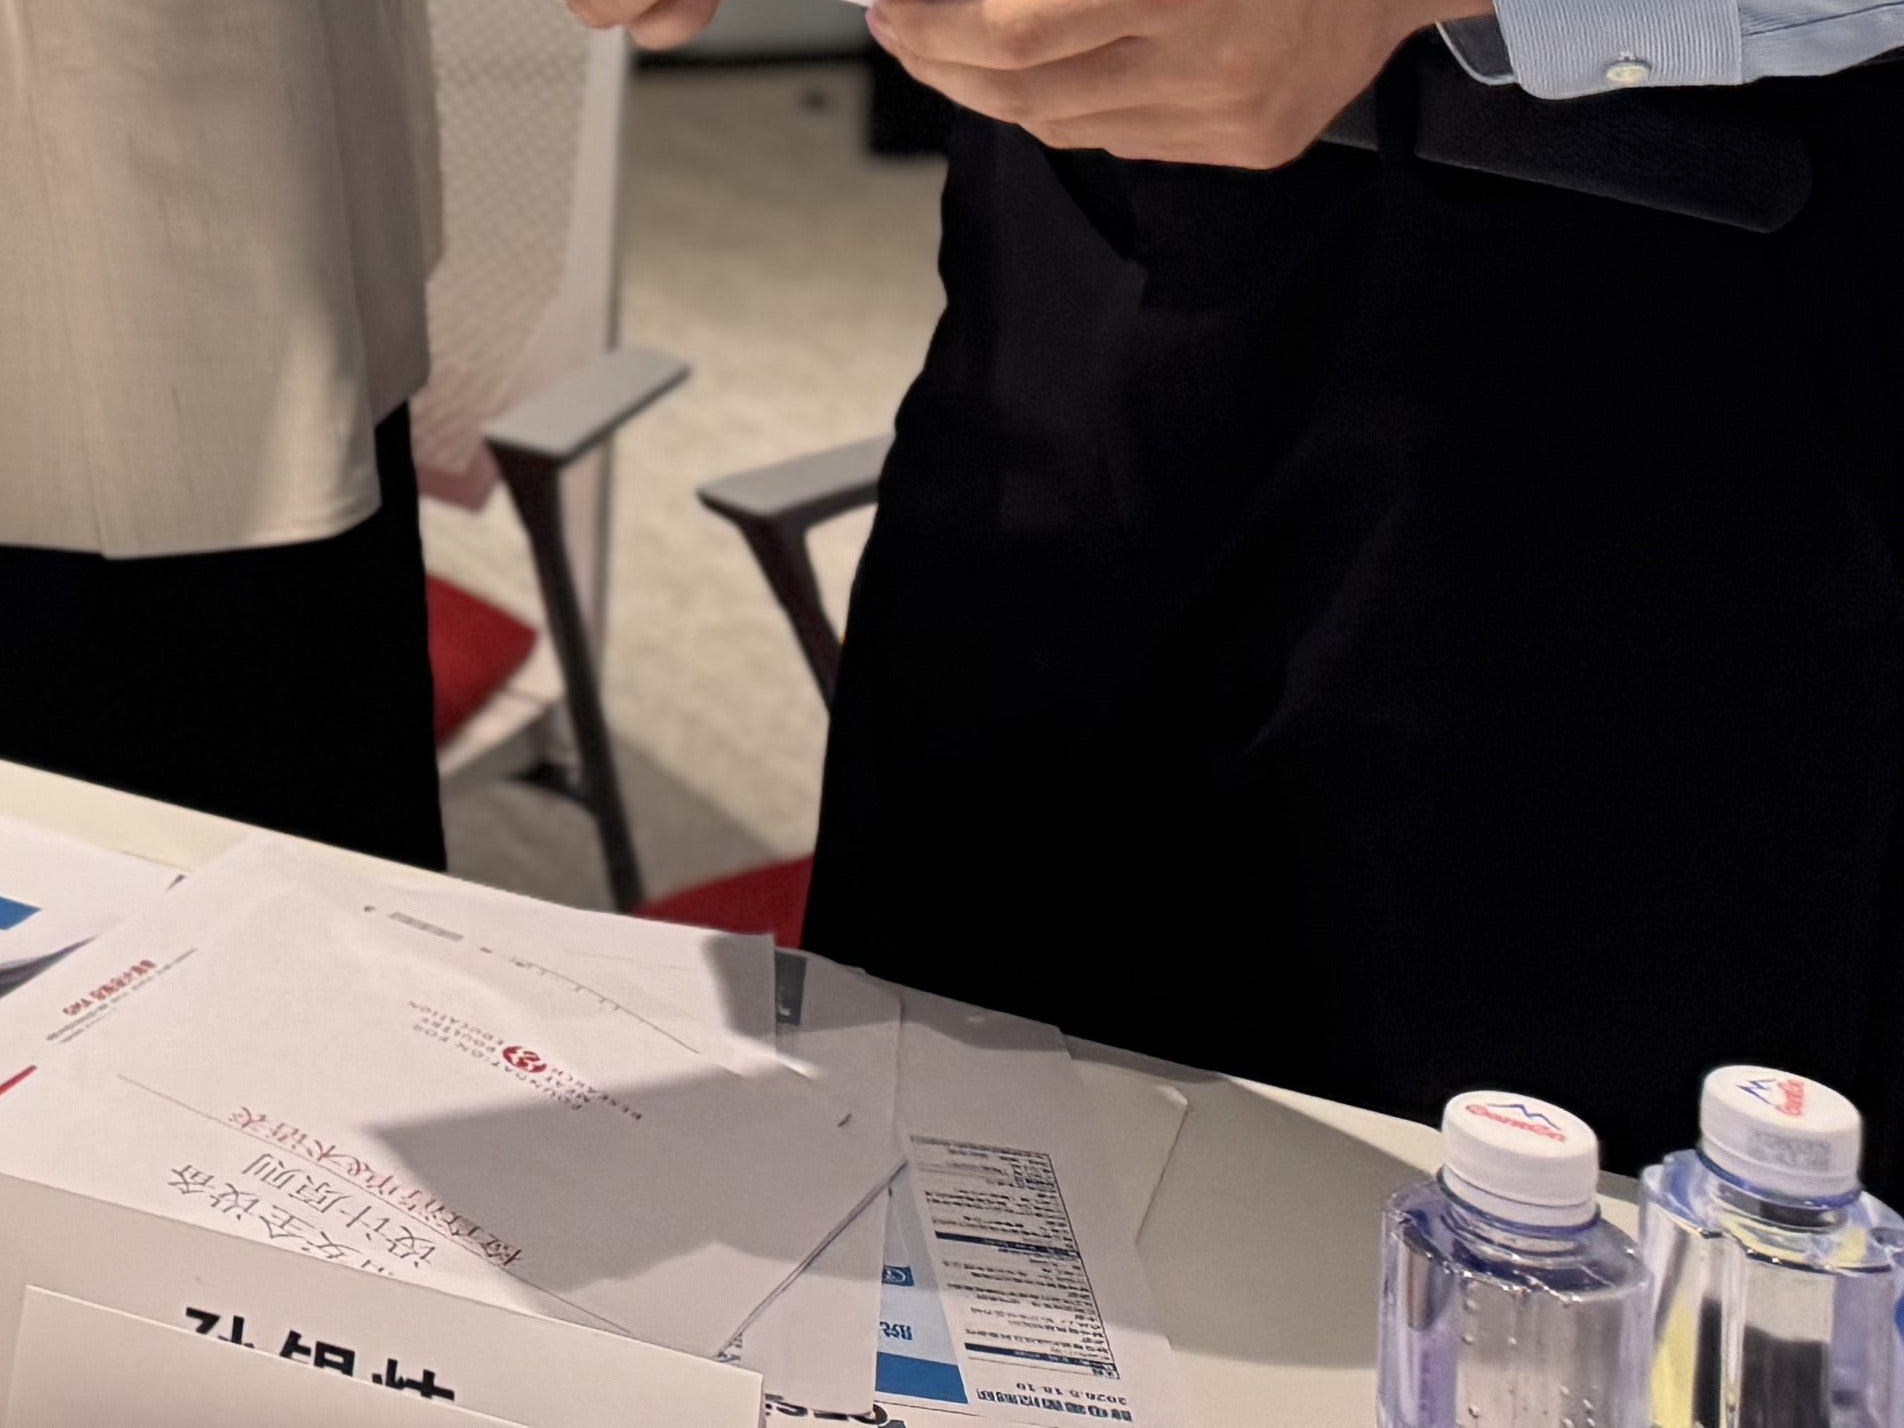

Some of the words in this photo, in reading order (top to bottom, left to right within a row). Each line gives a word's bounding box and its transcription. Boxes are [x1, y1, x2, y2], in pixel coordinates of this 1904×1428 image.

[168, 1164, 394, 1277] 安全设备
[242, 1153, 437, 1268] 设计原则
